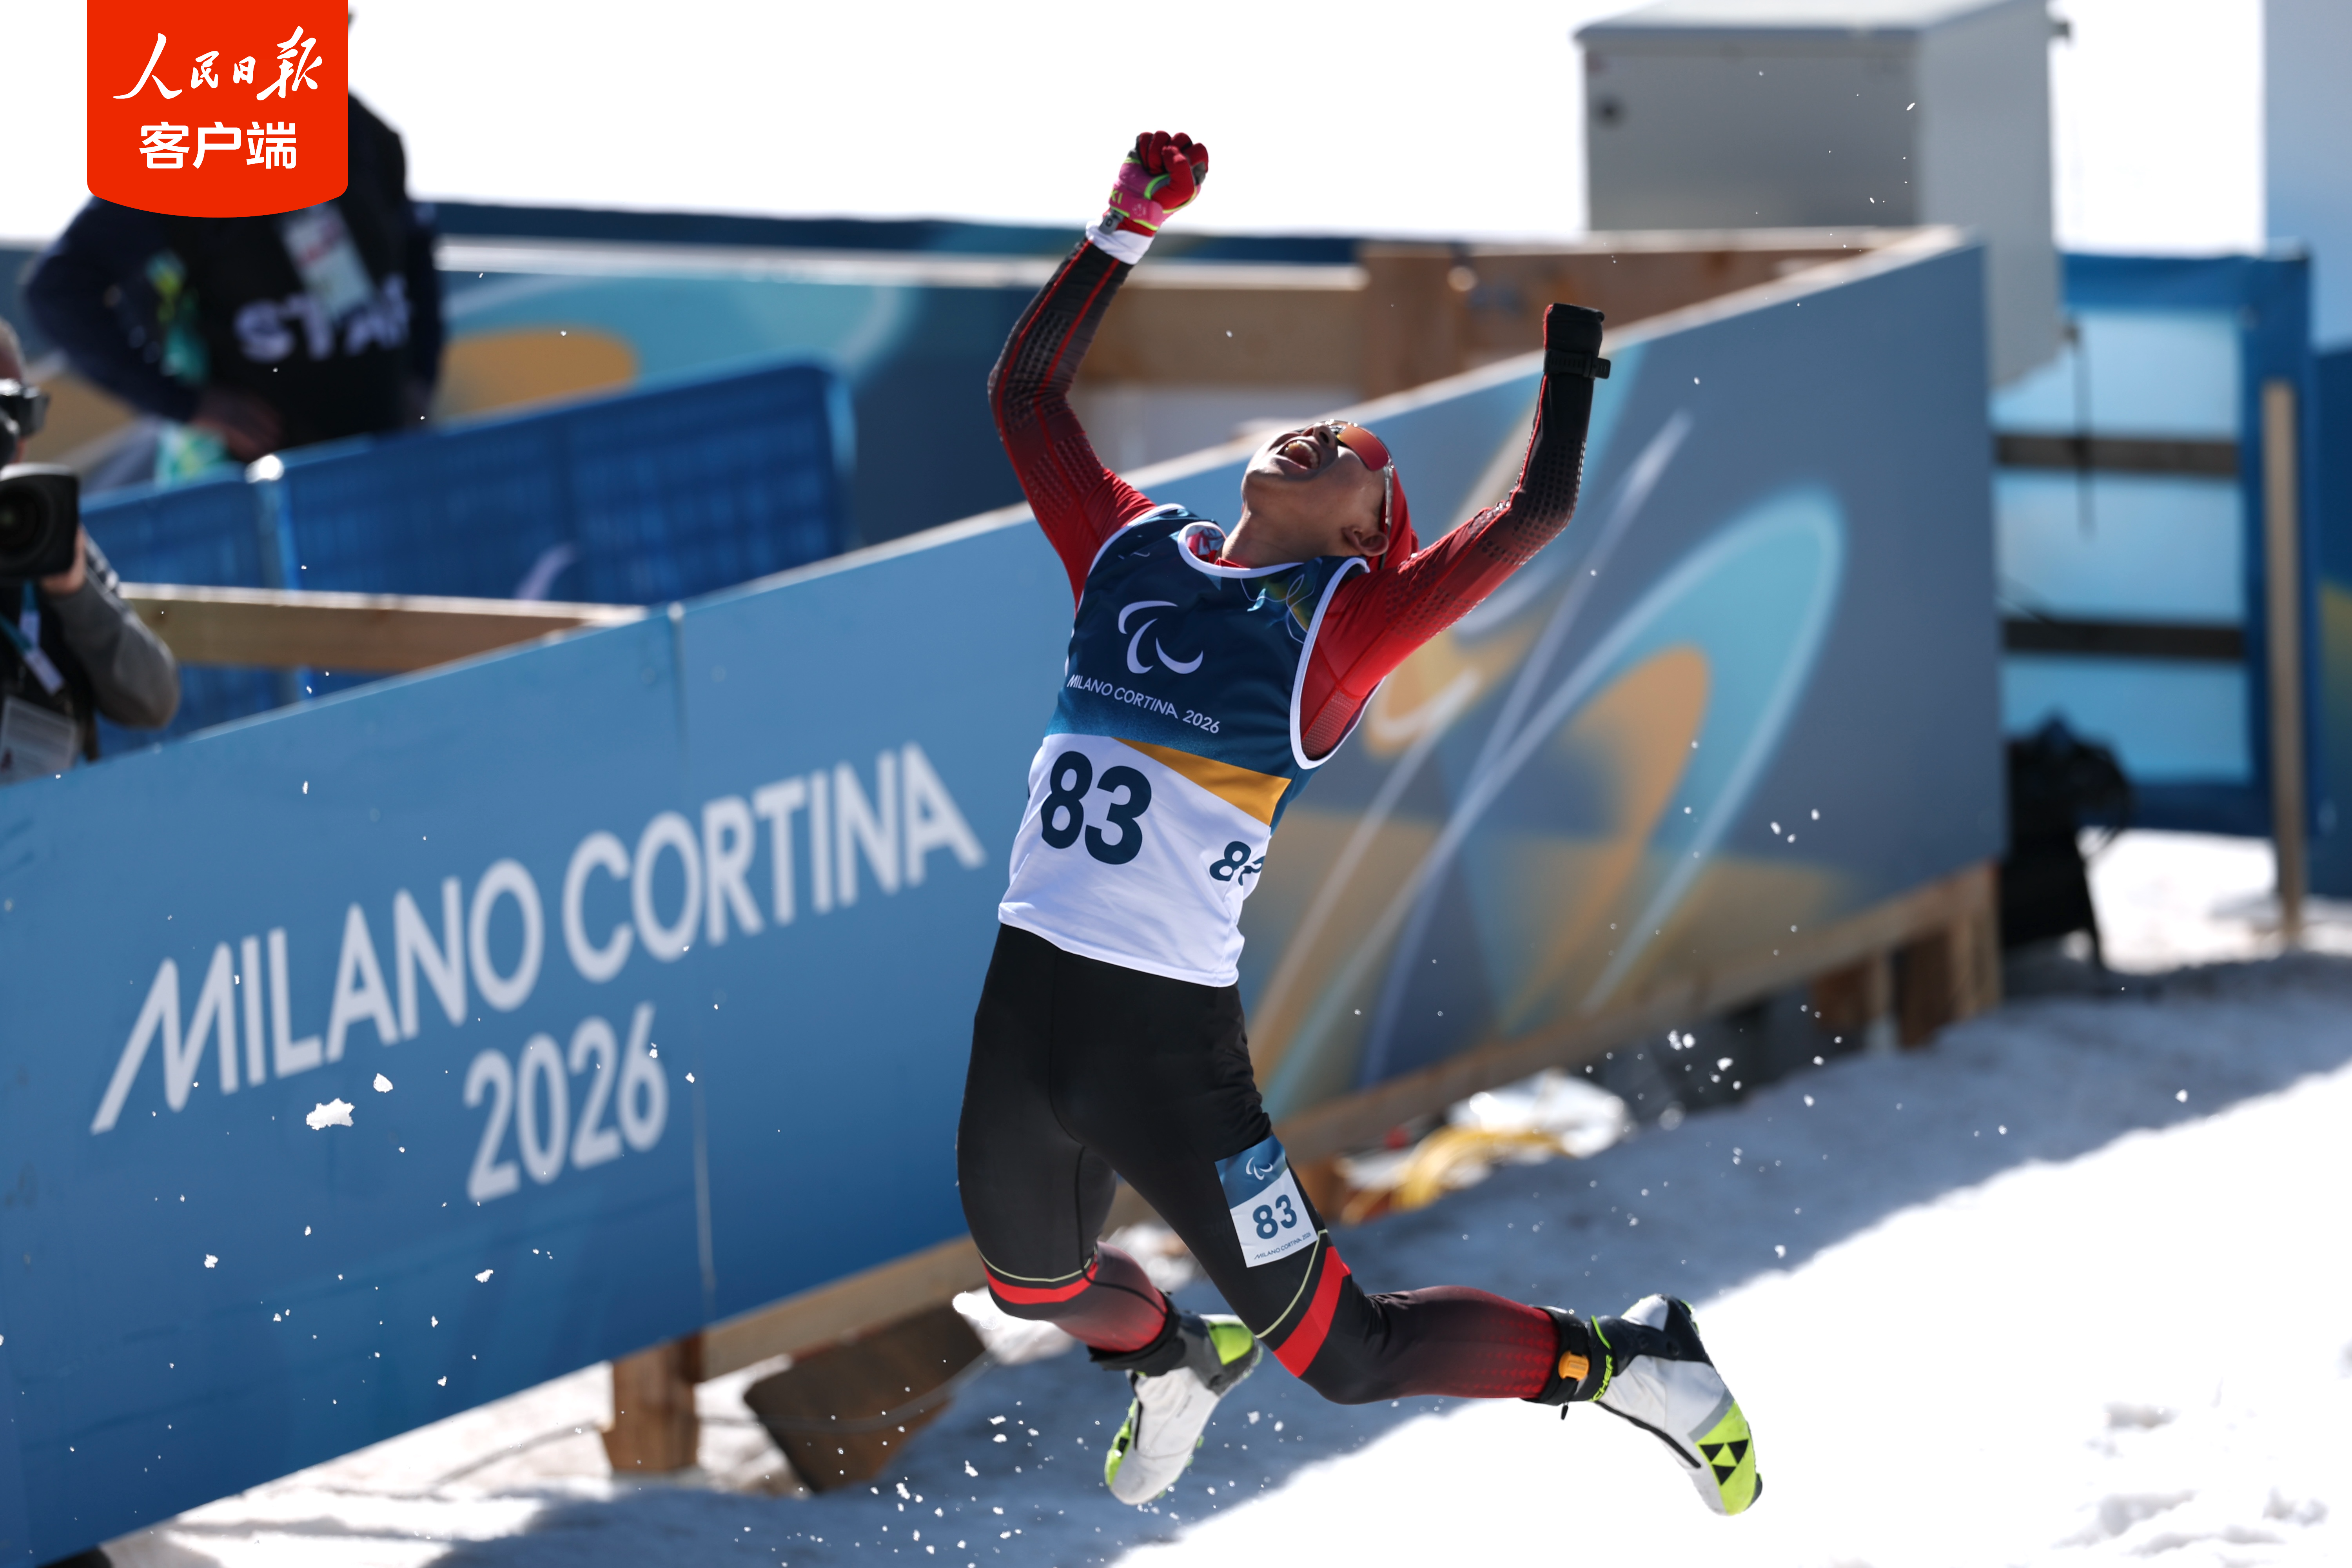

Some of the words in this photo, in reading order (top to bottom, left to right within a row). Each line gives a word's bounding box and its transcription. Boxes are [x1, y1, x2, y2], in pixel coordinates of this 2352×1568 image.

[1066, 674, 1113, 696] MILANO
[1114, 687, 1178, 719] CORTINA
[1182, 710, 1220, 734] 2026
[1041, 751, 1152, 865] 83
[90, 858, 545, 1134] MILANO
[561, 742, 985, 982] CORTINA
[463, 1002, 668, 1203] 2026
[1252, 1194, 1297, 1239] 83
[1254, 1247, 1280, 1260] MILANO
[1281, 1238, 1302, 1250] CORTINA
[1302, 1232, 1311, 1240] 2026
[1588, 1354, 1613, 1401] CHER
